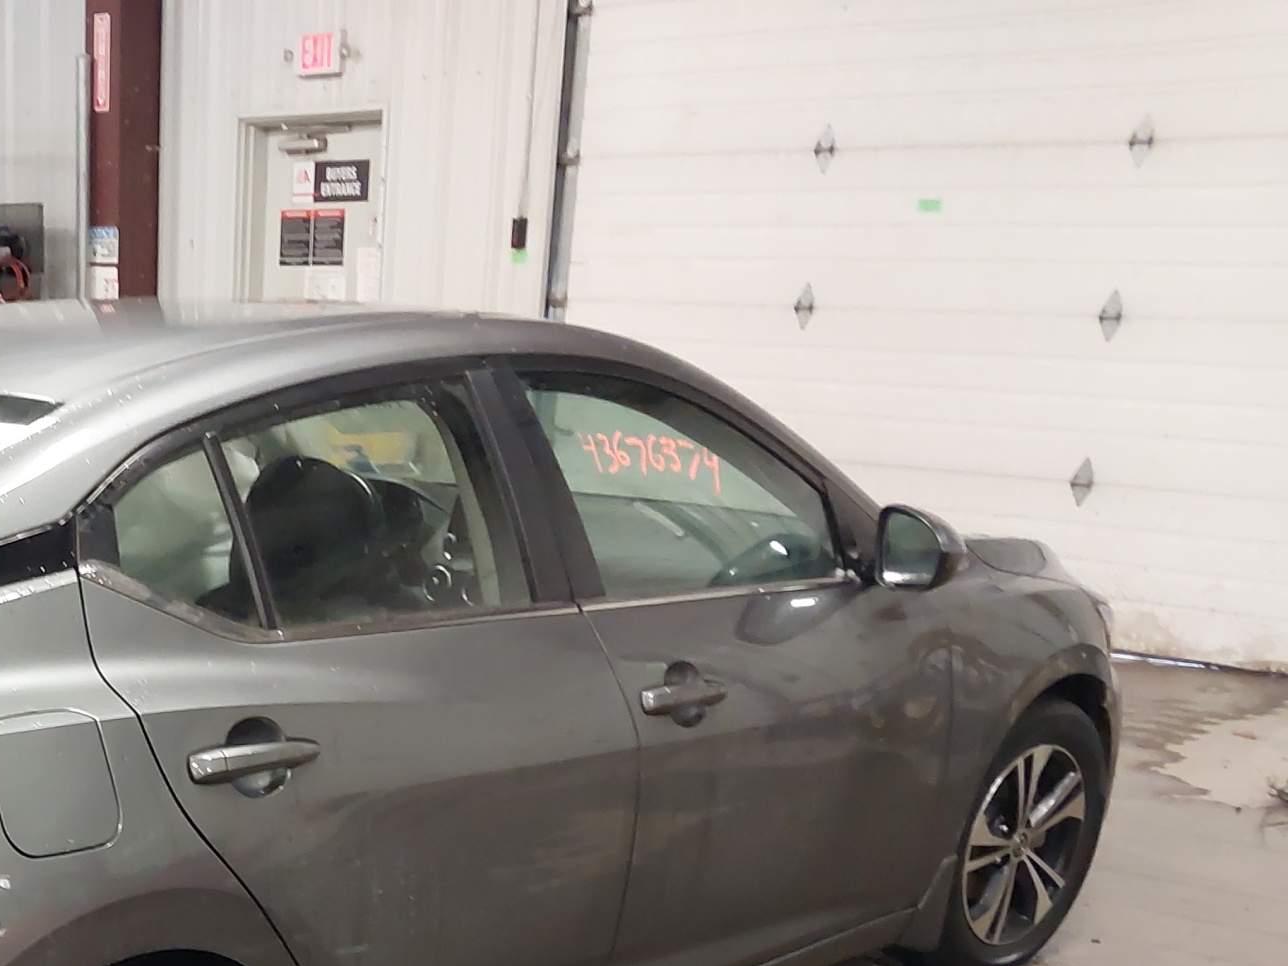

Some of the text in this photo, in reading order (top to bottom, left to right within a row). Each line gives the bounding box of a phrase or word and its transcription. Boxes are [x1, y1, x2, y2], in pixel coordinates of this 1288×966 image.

[302, 33, 333, 69] EXIT
[320, 181, 362, 198] ENTRANCE
[577, 430, 722, 496] 43676374
